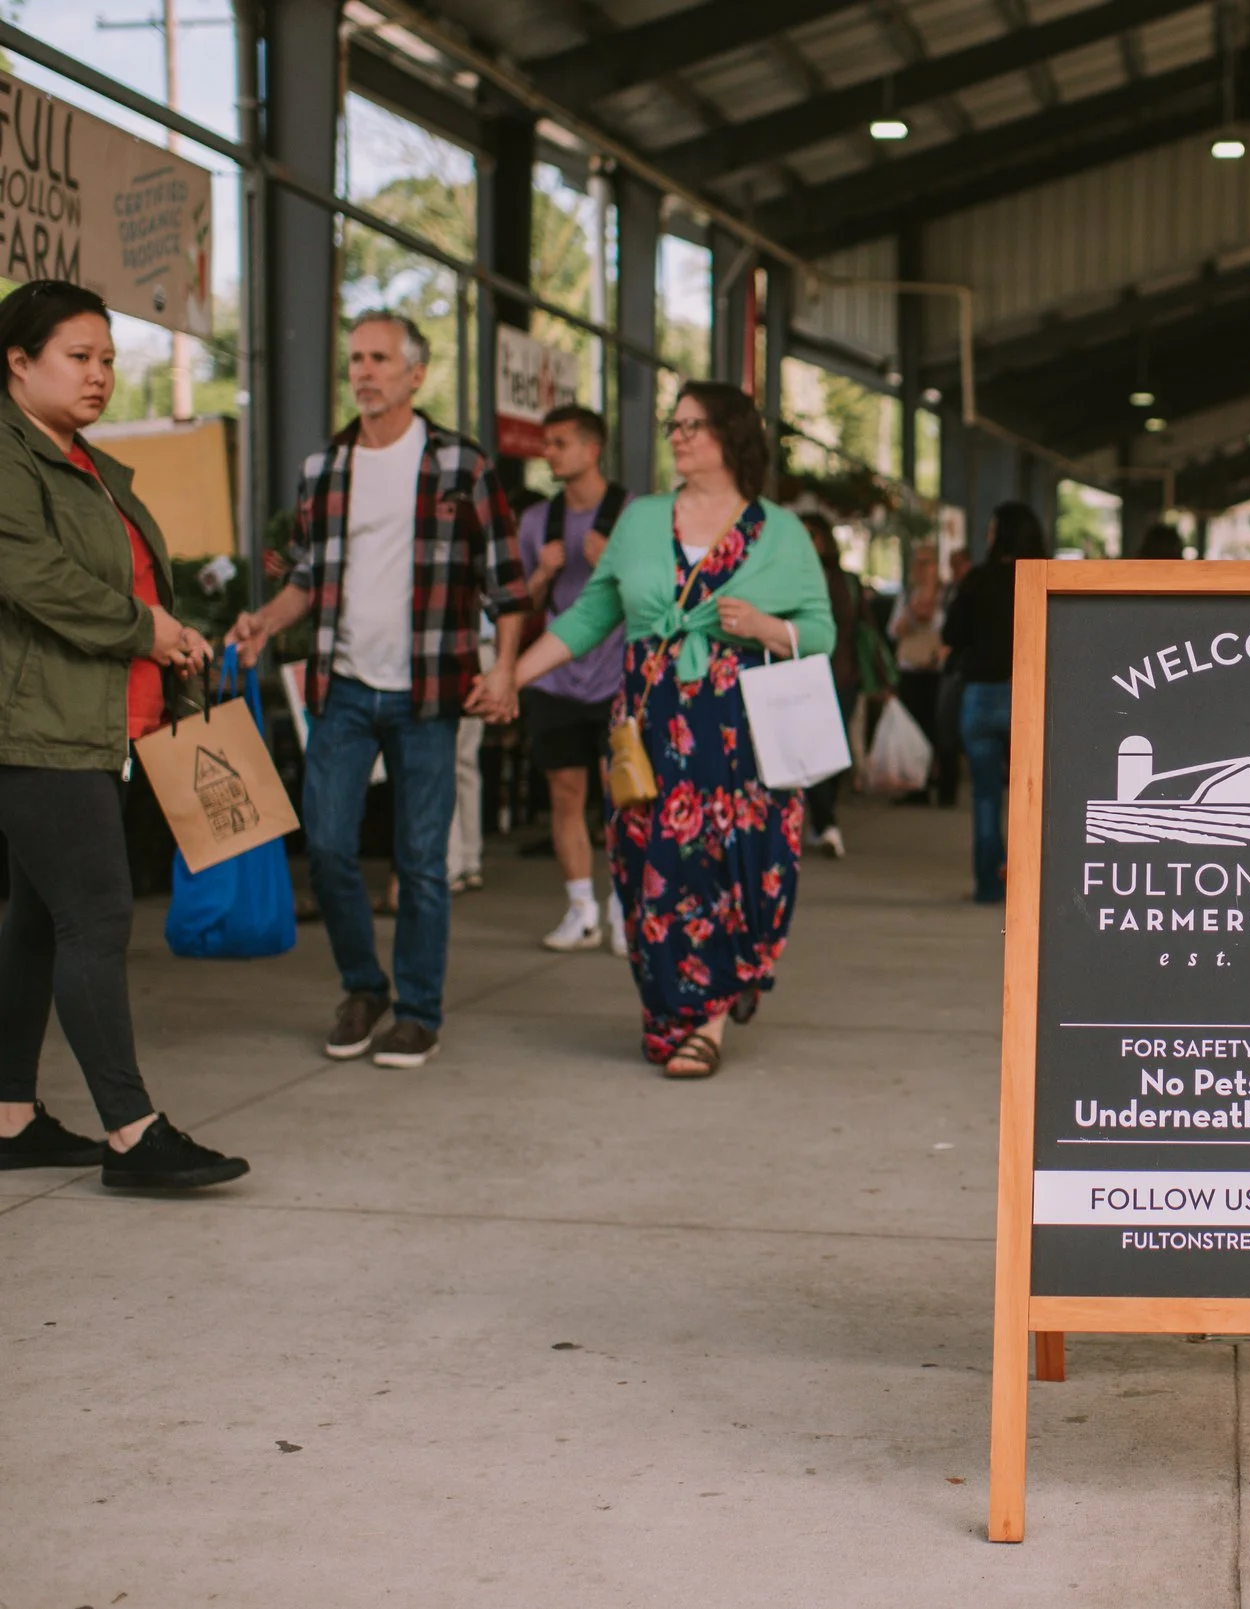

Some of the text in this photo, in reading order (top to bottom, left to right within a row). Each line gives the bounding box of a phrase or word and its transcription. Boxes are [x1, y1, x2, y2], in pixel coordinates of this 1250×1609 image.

[0, 80, 79, 190] FULL
[113, 179, 188, 217] CERTIFIED
[119, 205, 181, 242] ORGANIC
[122, 232, 181, 269] PRODUCE
[1159, 951, 1231, 967] est.
[1121, 1038, 1167, 1058] FOR
[1141, 1068, 1185, 1096] No
[1091, 1187, 1216, 1211] FOLLOW
